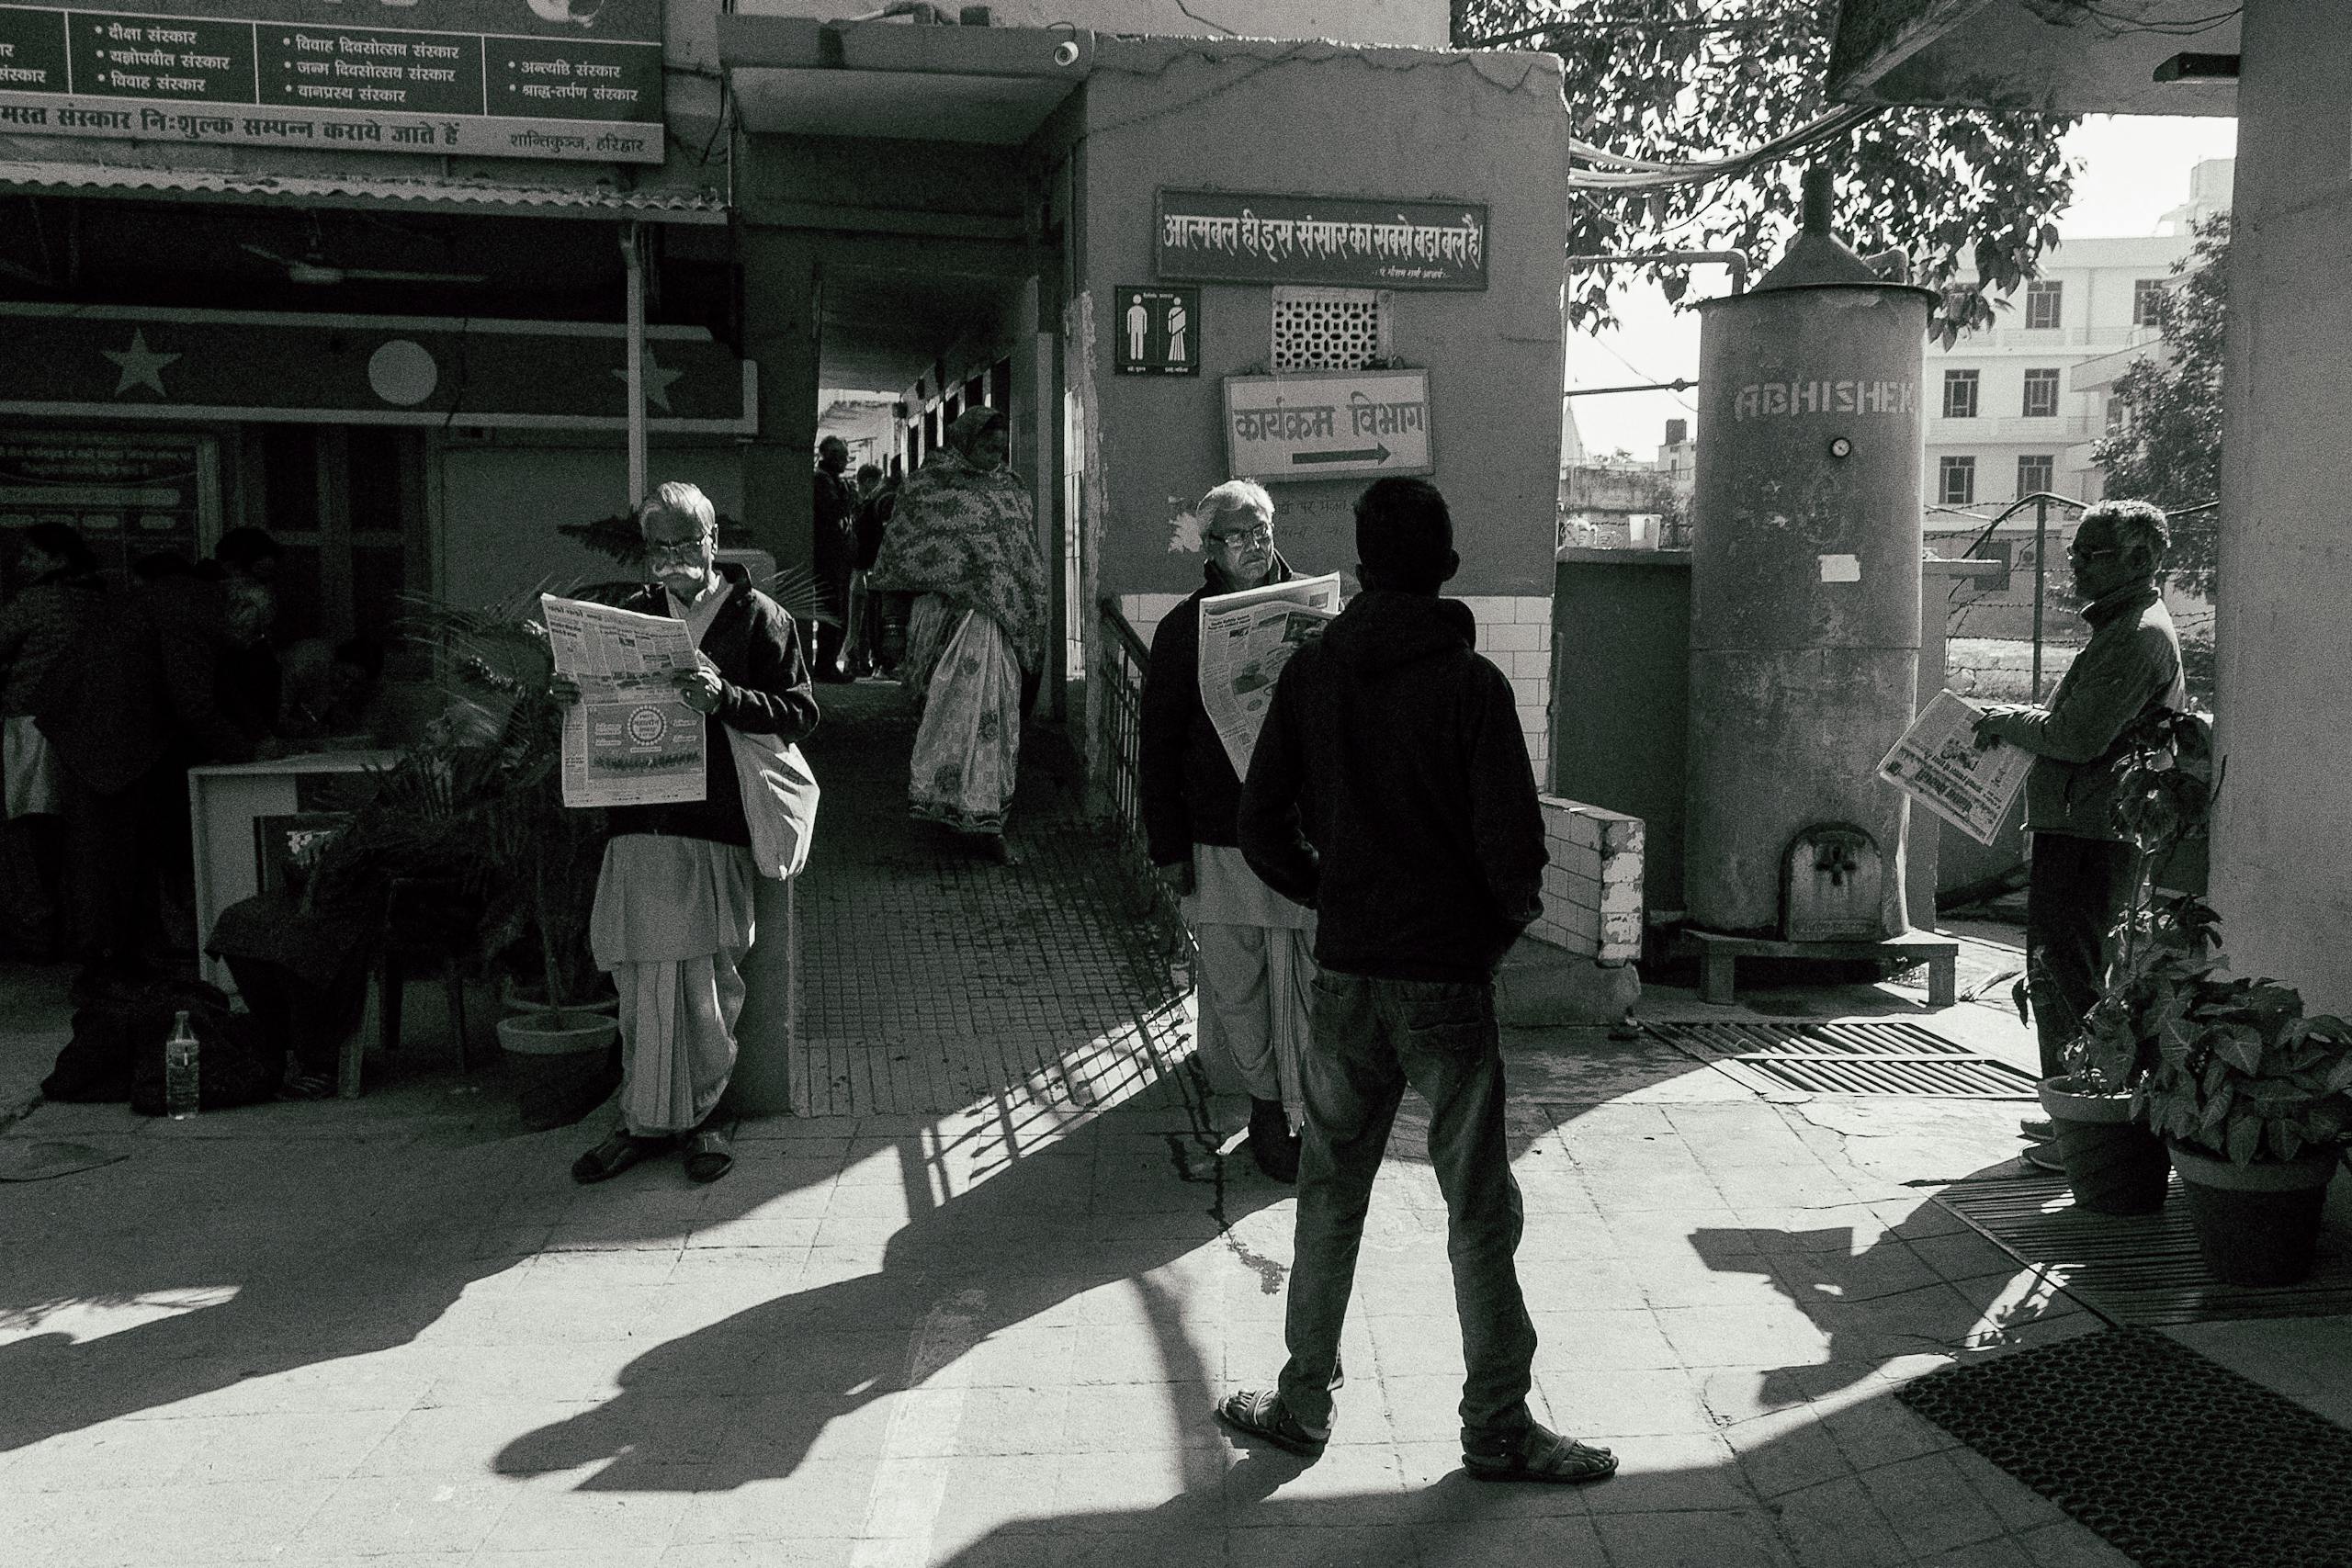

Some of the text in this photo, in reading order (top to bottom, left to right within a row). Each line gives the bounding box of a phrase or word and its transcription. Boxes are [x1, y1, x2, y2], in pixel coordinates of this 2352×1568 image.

[108, 23, 198, 44] दीक्षा संस्कार
[296, 34, 459, 60] विवाह दिवसोत्सव संस्कार
[109, 47, 231, 70] यज्ञोपवीत संस्कार
[575, 62, 621, 77] संस्कार
[111, 70, 206, 92] विवाह संस्कार
[297, 60, 456, 82] जन्म दिवसोत्सव संस्कार
[298, 85, 406, 102] वानप्रस्थ संस्कार
[593, 85, 639, 101] संस्कार
[0, 105, 47, 125] मस्त
[57, 102, 131, 130] संस्कार
[243, 118, 313, 138] सम्पन्न
[322, 118, 382, 141] कराये
[390, 121, 435, 144] जाते
[439, 121, 459, 145] हैं
[597, 132, 644, 152] हरिद्वार
[1241, 209, 1260, 256] ही
[1261, 219, 1295, 263] इस
[1296, 214, 1350, 260] संसार
[1350, 223, 1373, 255] का
[1734, 380, 1916, 423] ABHISHEK
[1233, 390, 1425, 442] कार्यक्रम विभाग
